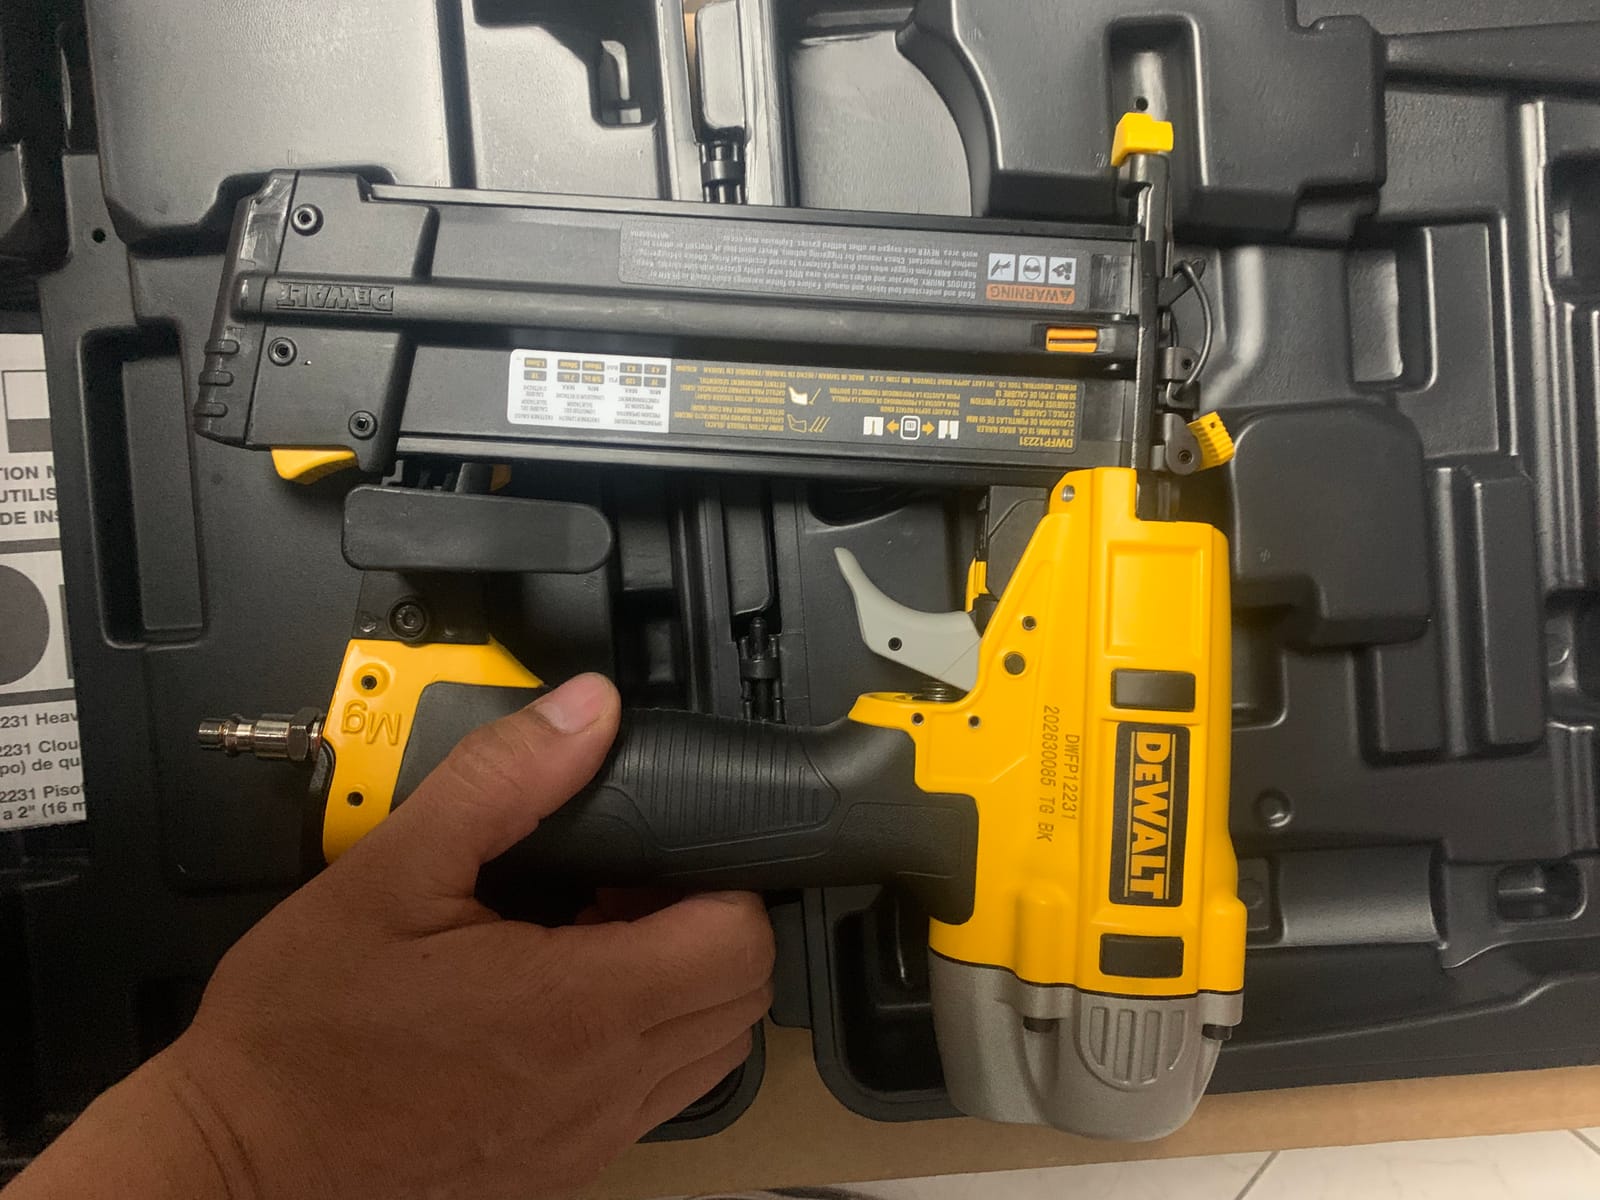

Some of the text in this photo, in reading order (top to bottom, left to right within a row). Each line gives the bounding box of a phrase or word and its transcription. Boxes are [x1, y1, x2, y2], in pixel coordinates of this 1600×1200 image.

[277, 283, 394, 311] DEWALT
[989, 285, 1059, 300] WARNING
[1018, 435, 1073, 448] DWFP12231
[0, 714, 28, 729] 231
[341, 700, 402, 746] Mg
[38, 740, 78, 753] Clou
[32, 759, 53, 772] de
[59, 757, 80, 771] qu
[1036, 705, 1060, 842] 202630085 TG BK
[1061, 734, 1081, 820] DWFP12231
[43, 784, 84, 799] Piso
[3, 810, 12, 820] a
[42, 801, 67, 817] (16
